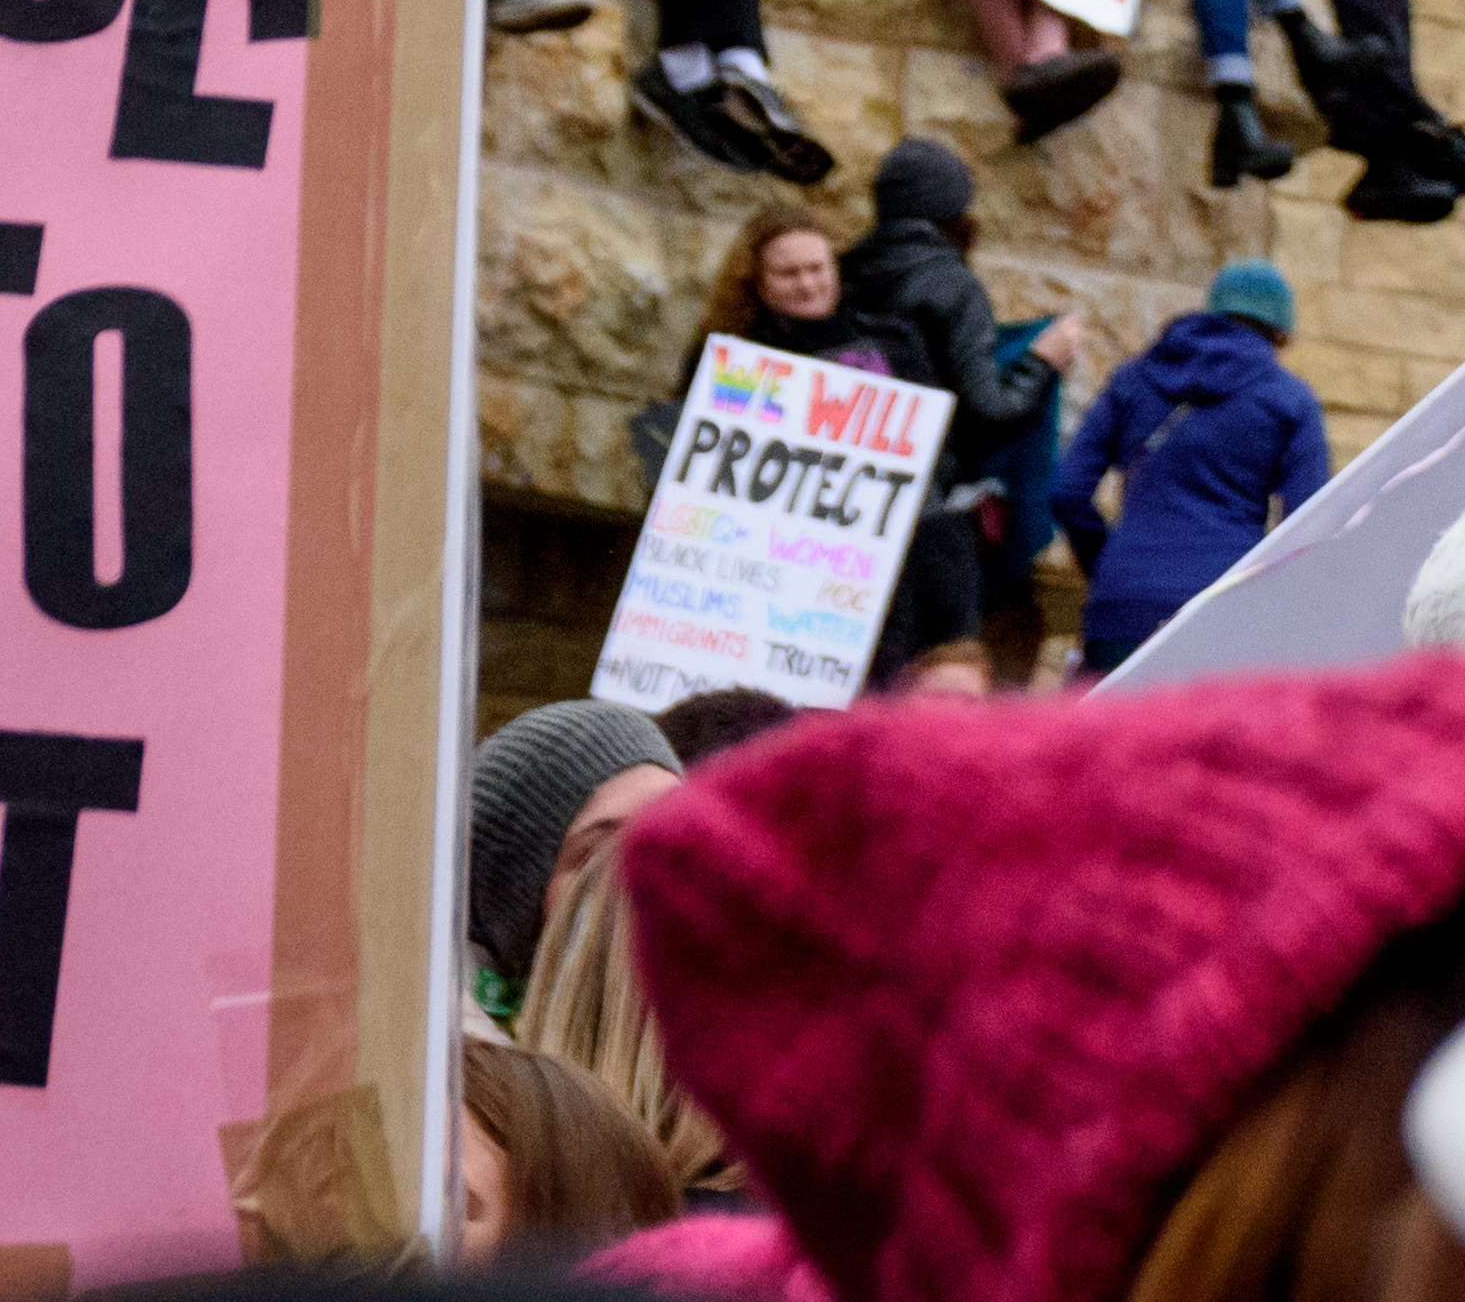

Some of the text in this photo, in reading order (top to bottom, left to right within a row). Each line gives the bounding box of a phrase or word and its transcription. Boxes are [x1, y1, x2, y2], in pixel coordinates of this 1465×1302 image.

[711, 344, 920, 457] WE WILL
[676, 418, 917, 537] PROTECT
[640, 533, 782, 595] BLACK LIVES
[768, 522, 876, 581] WOMEN
[629, 569, 744, 622] MUSLIMS
[614, 608, 749, 662] IMMIGRANTS
[764, 638, 854, 690] TRUTH
